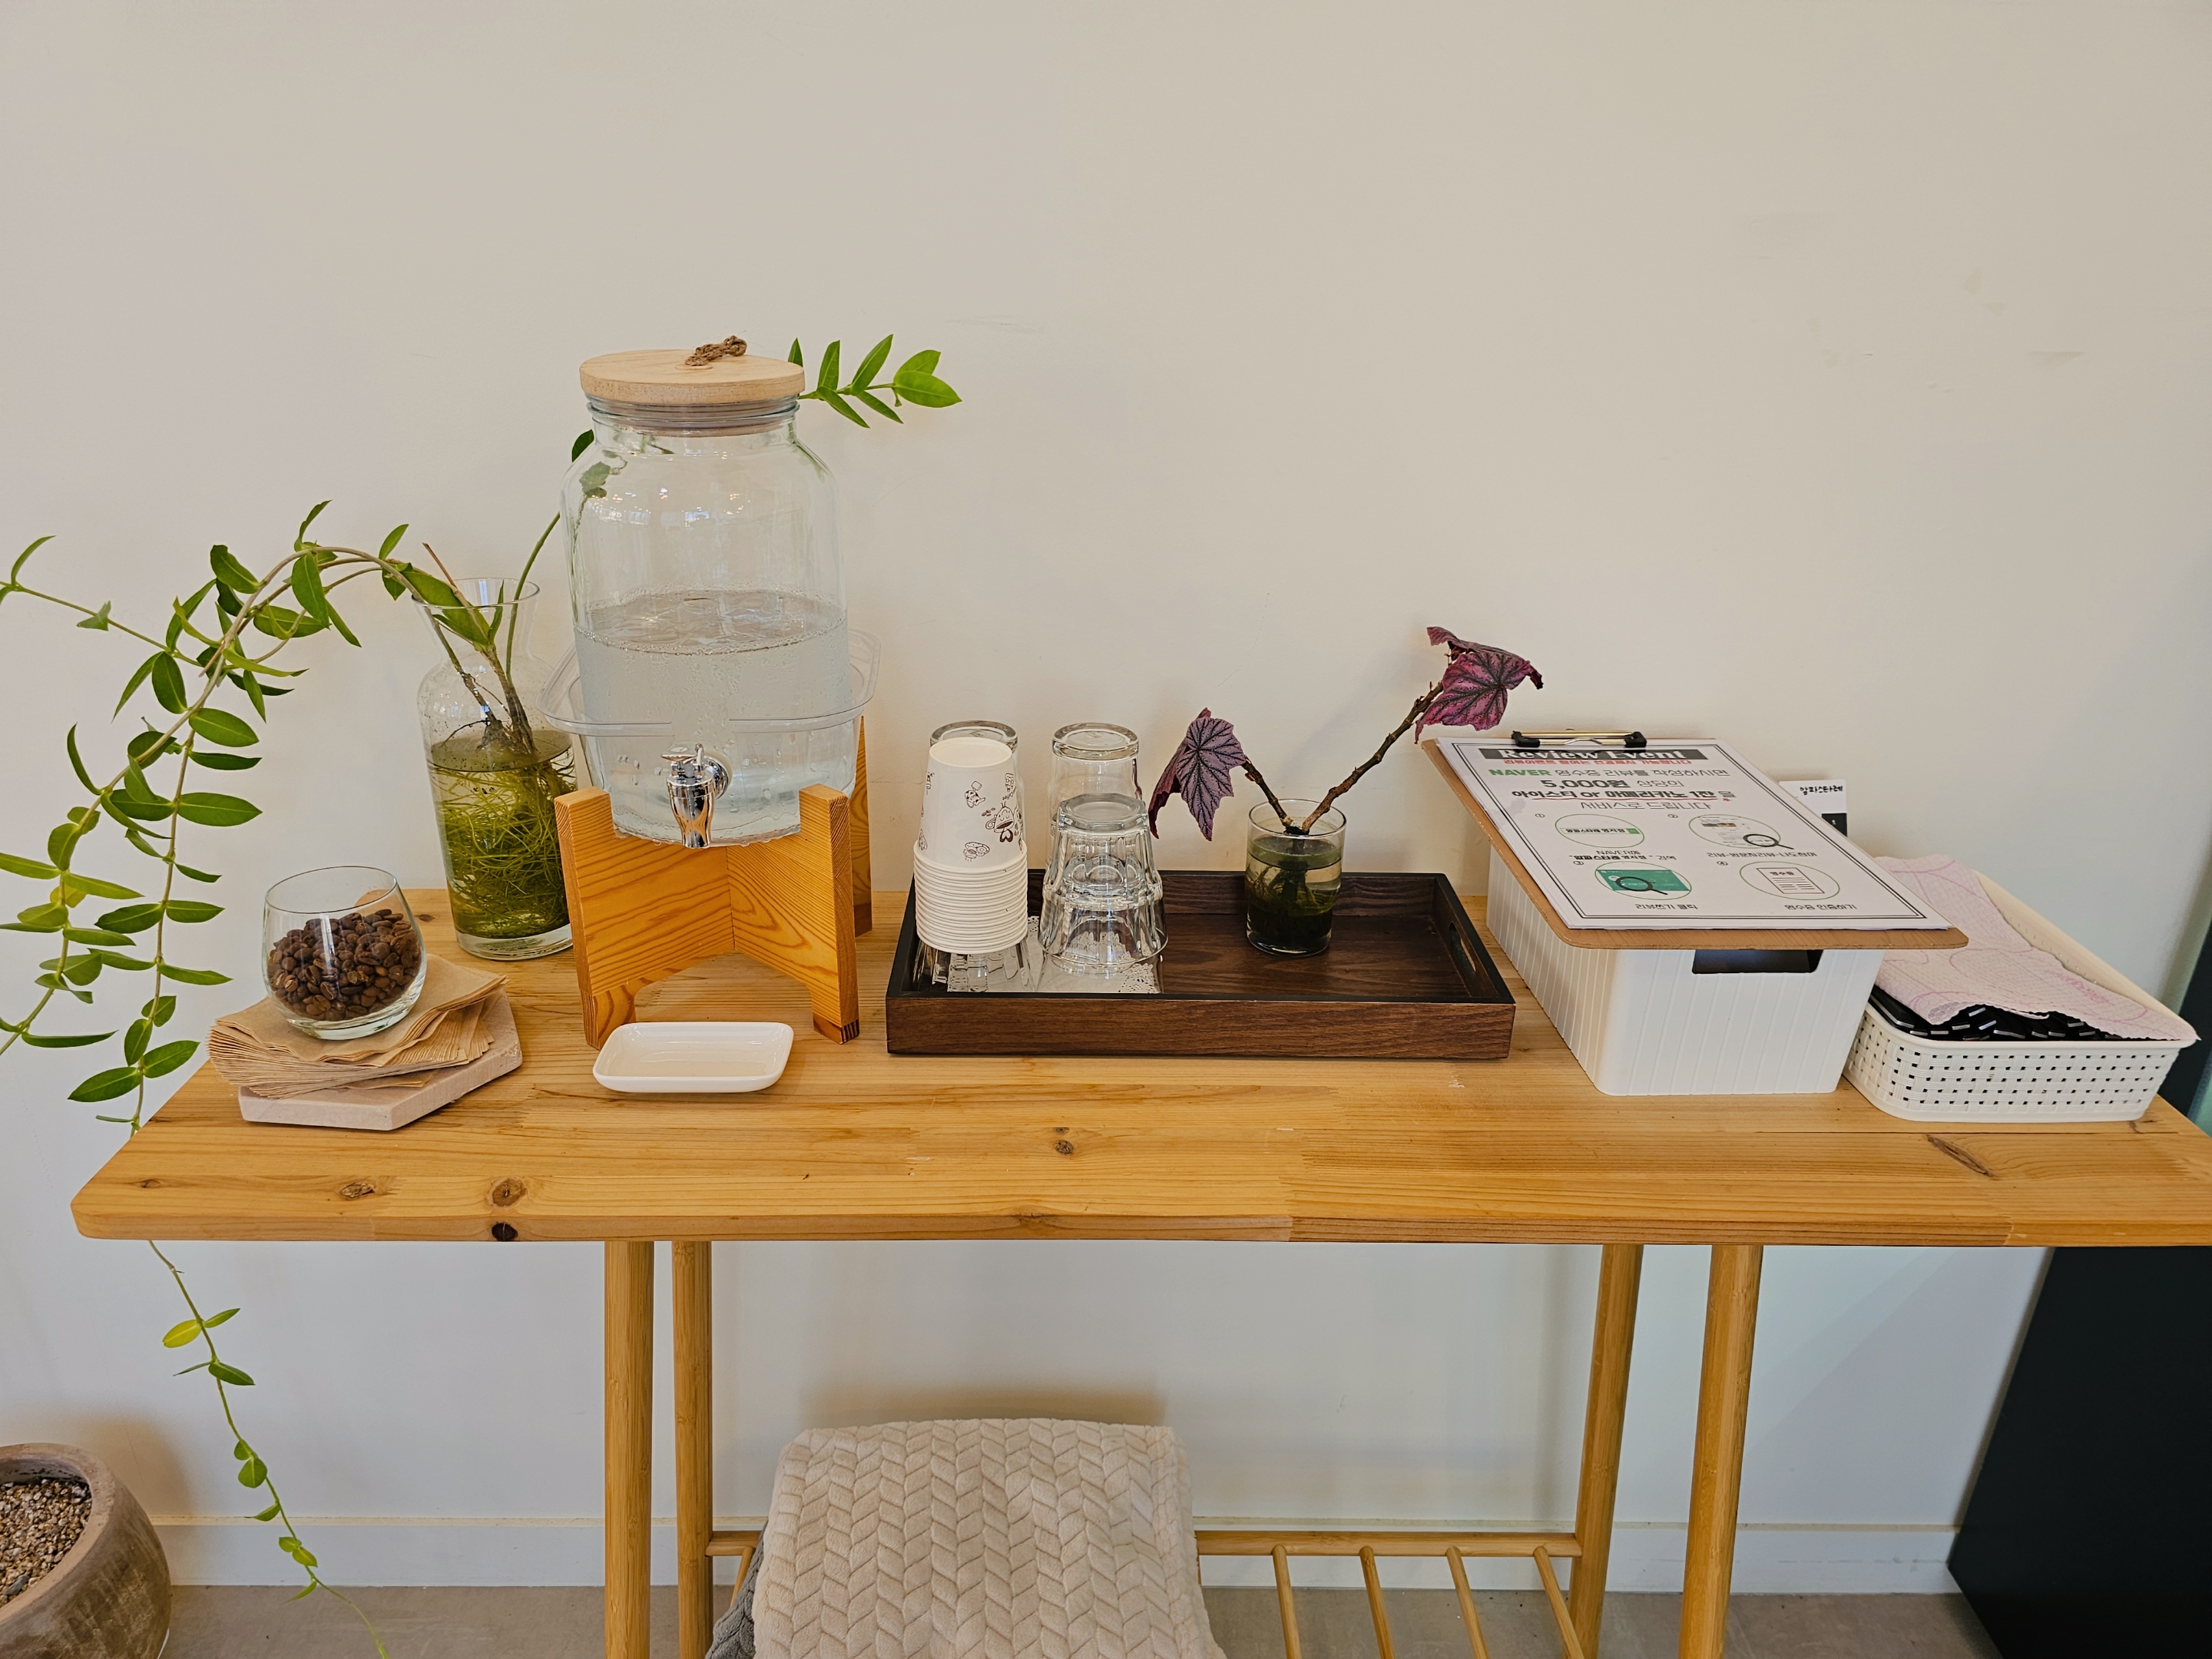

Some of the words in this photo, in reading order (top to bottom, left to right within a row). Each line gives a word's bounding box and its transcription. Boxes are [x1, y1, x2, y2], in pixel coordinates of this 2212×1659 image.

[1498, 750, 1598, 759] Review
[1606, 750, 1687, 759] Event
[1540, 780, 1631, 789] 5,000원
